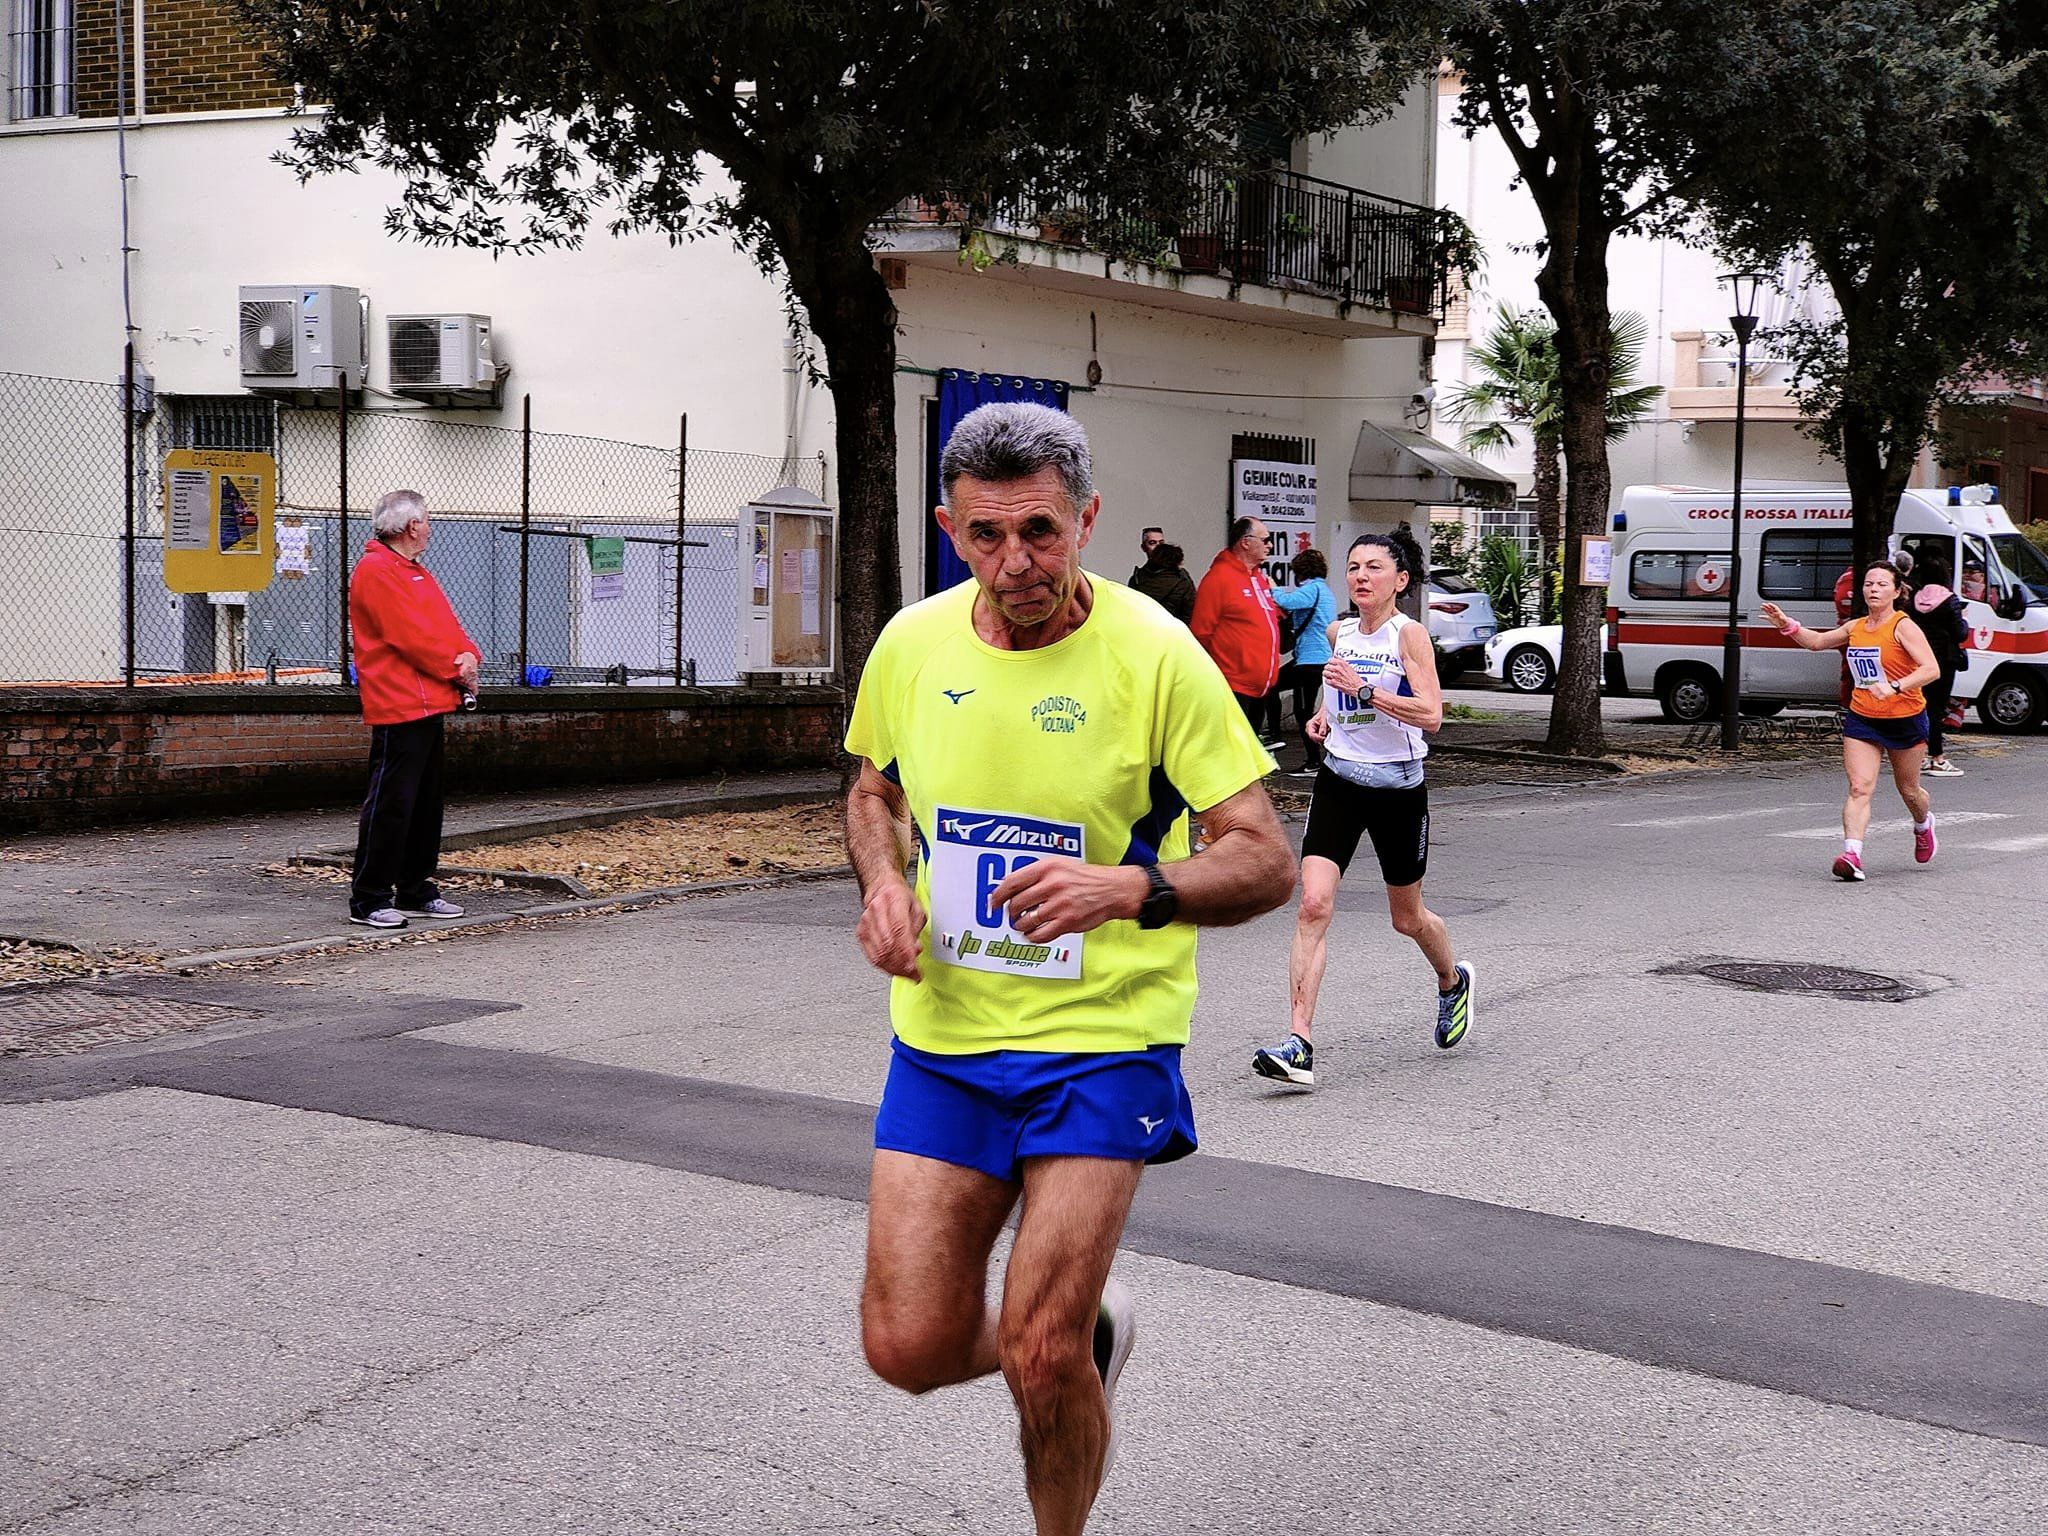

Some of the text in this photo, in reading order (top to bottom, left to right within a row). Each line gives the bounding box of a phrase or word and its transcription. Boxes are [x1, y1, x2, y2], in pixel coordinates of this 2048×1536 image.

[1744, 509, 1798, 520] ROSSA
[1854, 658, 1878, 678] 109
[1031, 695, 1087, 726] PODISTICA
[984, 934, 1051, 963] shine
[1005, 959, 1042, 969] SPORT
